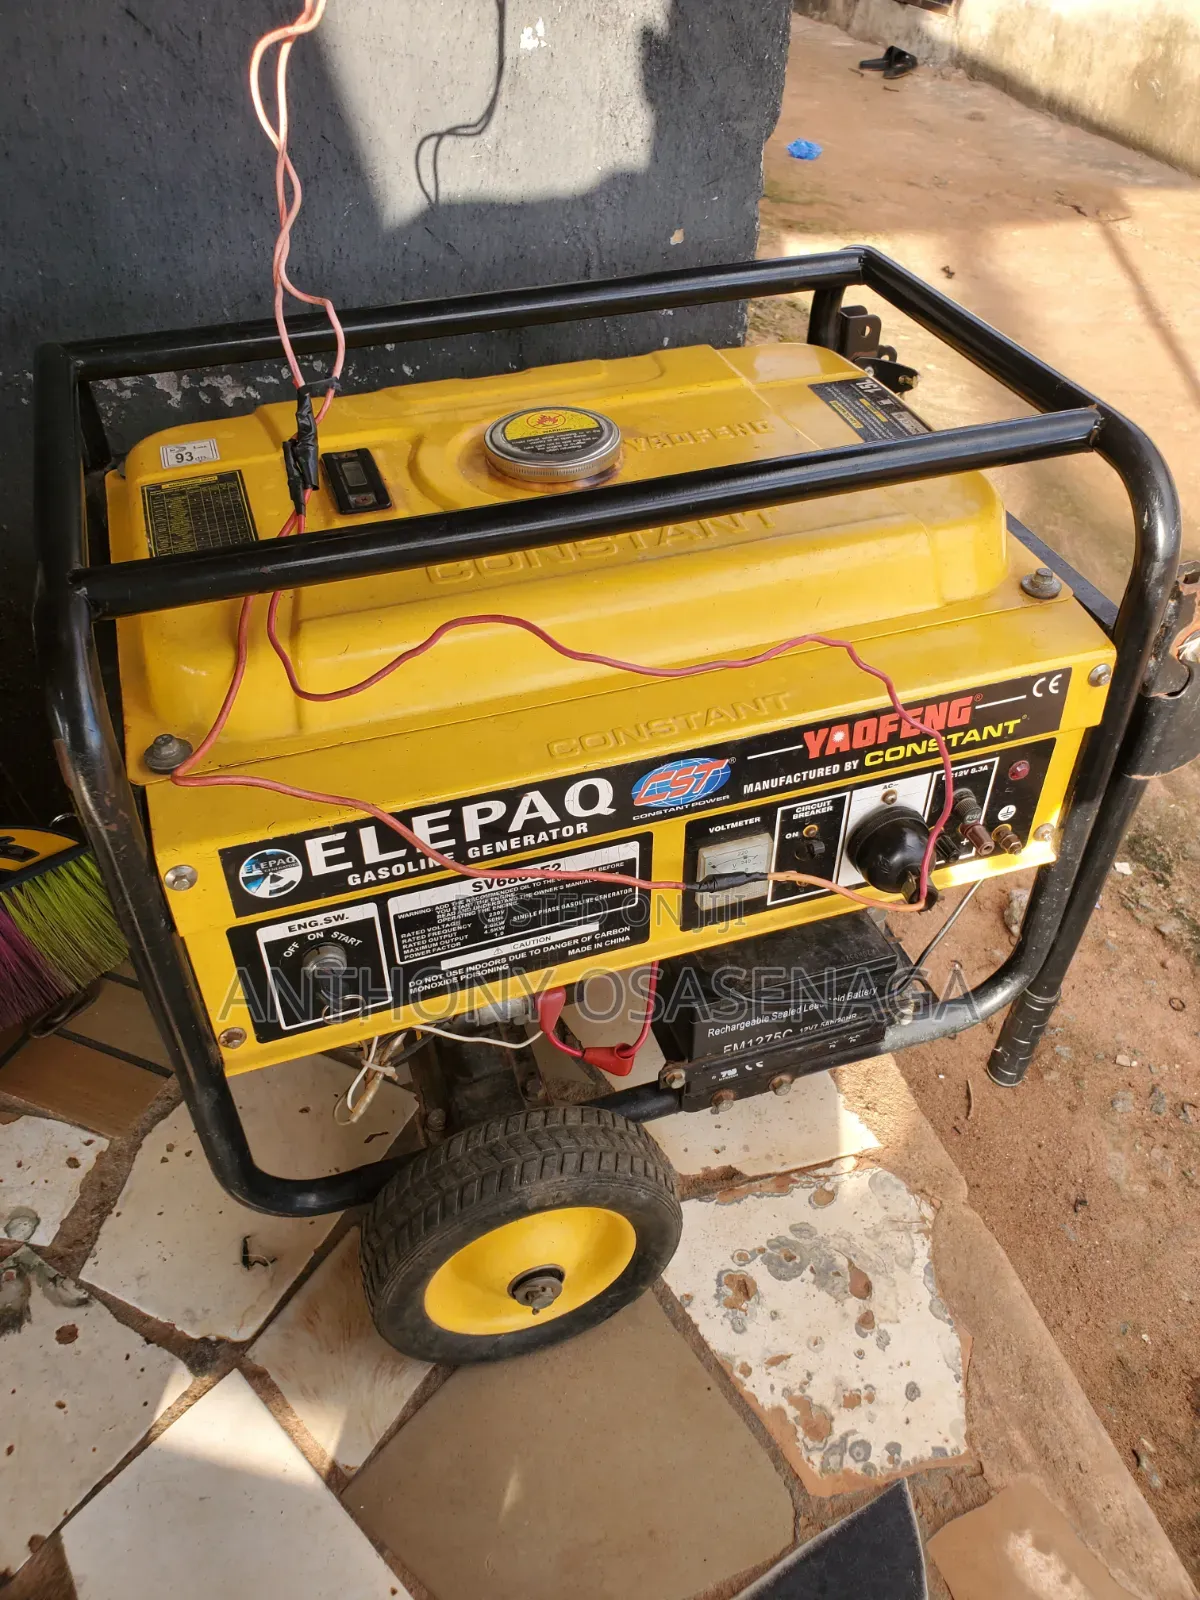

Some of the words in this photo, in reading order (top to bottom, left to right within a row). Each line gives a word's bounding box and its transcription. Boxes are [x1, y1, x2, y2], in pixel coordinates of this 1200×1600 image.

[175, 451, 194, 463] 93
[547, 692, 791, 760] CONSTANT
[803, 695, 974, 760] YAOFENG
[743, 763, 840, 794] MANUFACTURED
[844, 759, 859, 770] BY
[864, 719, 1021, 767] CONSTANT
[632, 804, 690, 821] CONSTANT
[691, 795, 730, 808] POWER
[792, 805, 834, 820] BREAKER
[795, 800, 832, 814] CIRCUIT
[305, 777, 616, 876] ELEPAQ
[708, 816, 761, 834] VOLTMETER
[468, 822, 588, 859] GENERATOR
[785, 831, 799, 839] ON
[243, 855, 297, 874] ELEPAQ
[598, 861, 625, 872] BEFORE
[287, 913, 350, 933] ENG.SW.
[307, 931, 325, 941] ON
[331, 931, 363, 946] START
[403, 942, 439, 955] MAXIMUM
[440, 934, 469, 946] OUTPUT
[512, 935, 552, 951] CAUTION
[568, 944, 593, 956] MADE
[594, 941, 603, 949] IN
[604, 935, 631, 946] CHINA
[283, 941, 300, 958] OFF
[404, 949, 432, 960] POWER
[432, 942, 462, 953] FACTOR
[408, 979, 422, 988] DO
[424, 973, 444, 983] NOT
[445, 968, 465, 978] USE
[466, 956, 507, 973] INDOORS
[508, 953, 527, 962] DUE
[529, 948, 541, 957] TO
[542, 938, 579, 953] DANGER
[581, 935, 593, 943] OF
[594, 925, 631, 940] CARBON
[409, 978, 459, 995] MONOXIDE
[460, 963, 510, 981] POISONING
[707, 1014, 770, 1038] Rechargeable
[771, 1004, 802, 1021] Sealed
[846, 986, 878, 1001] Battery
